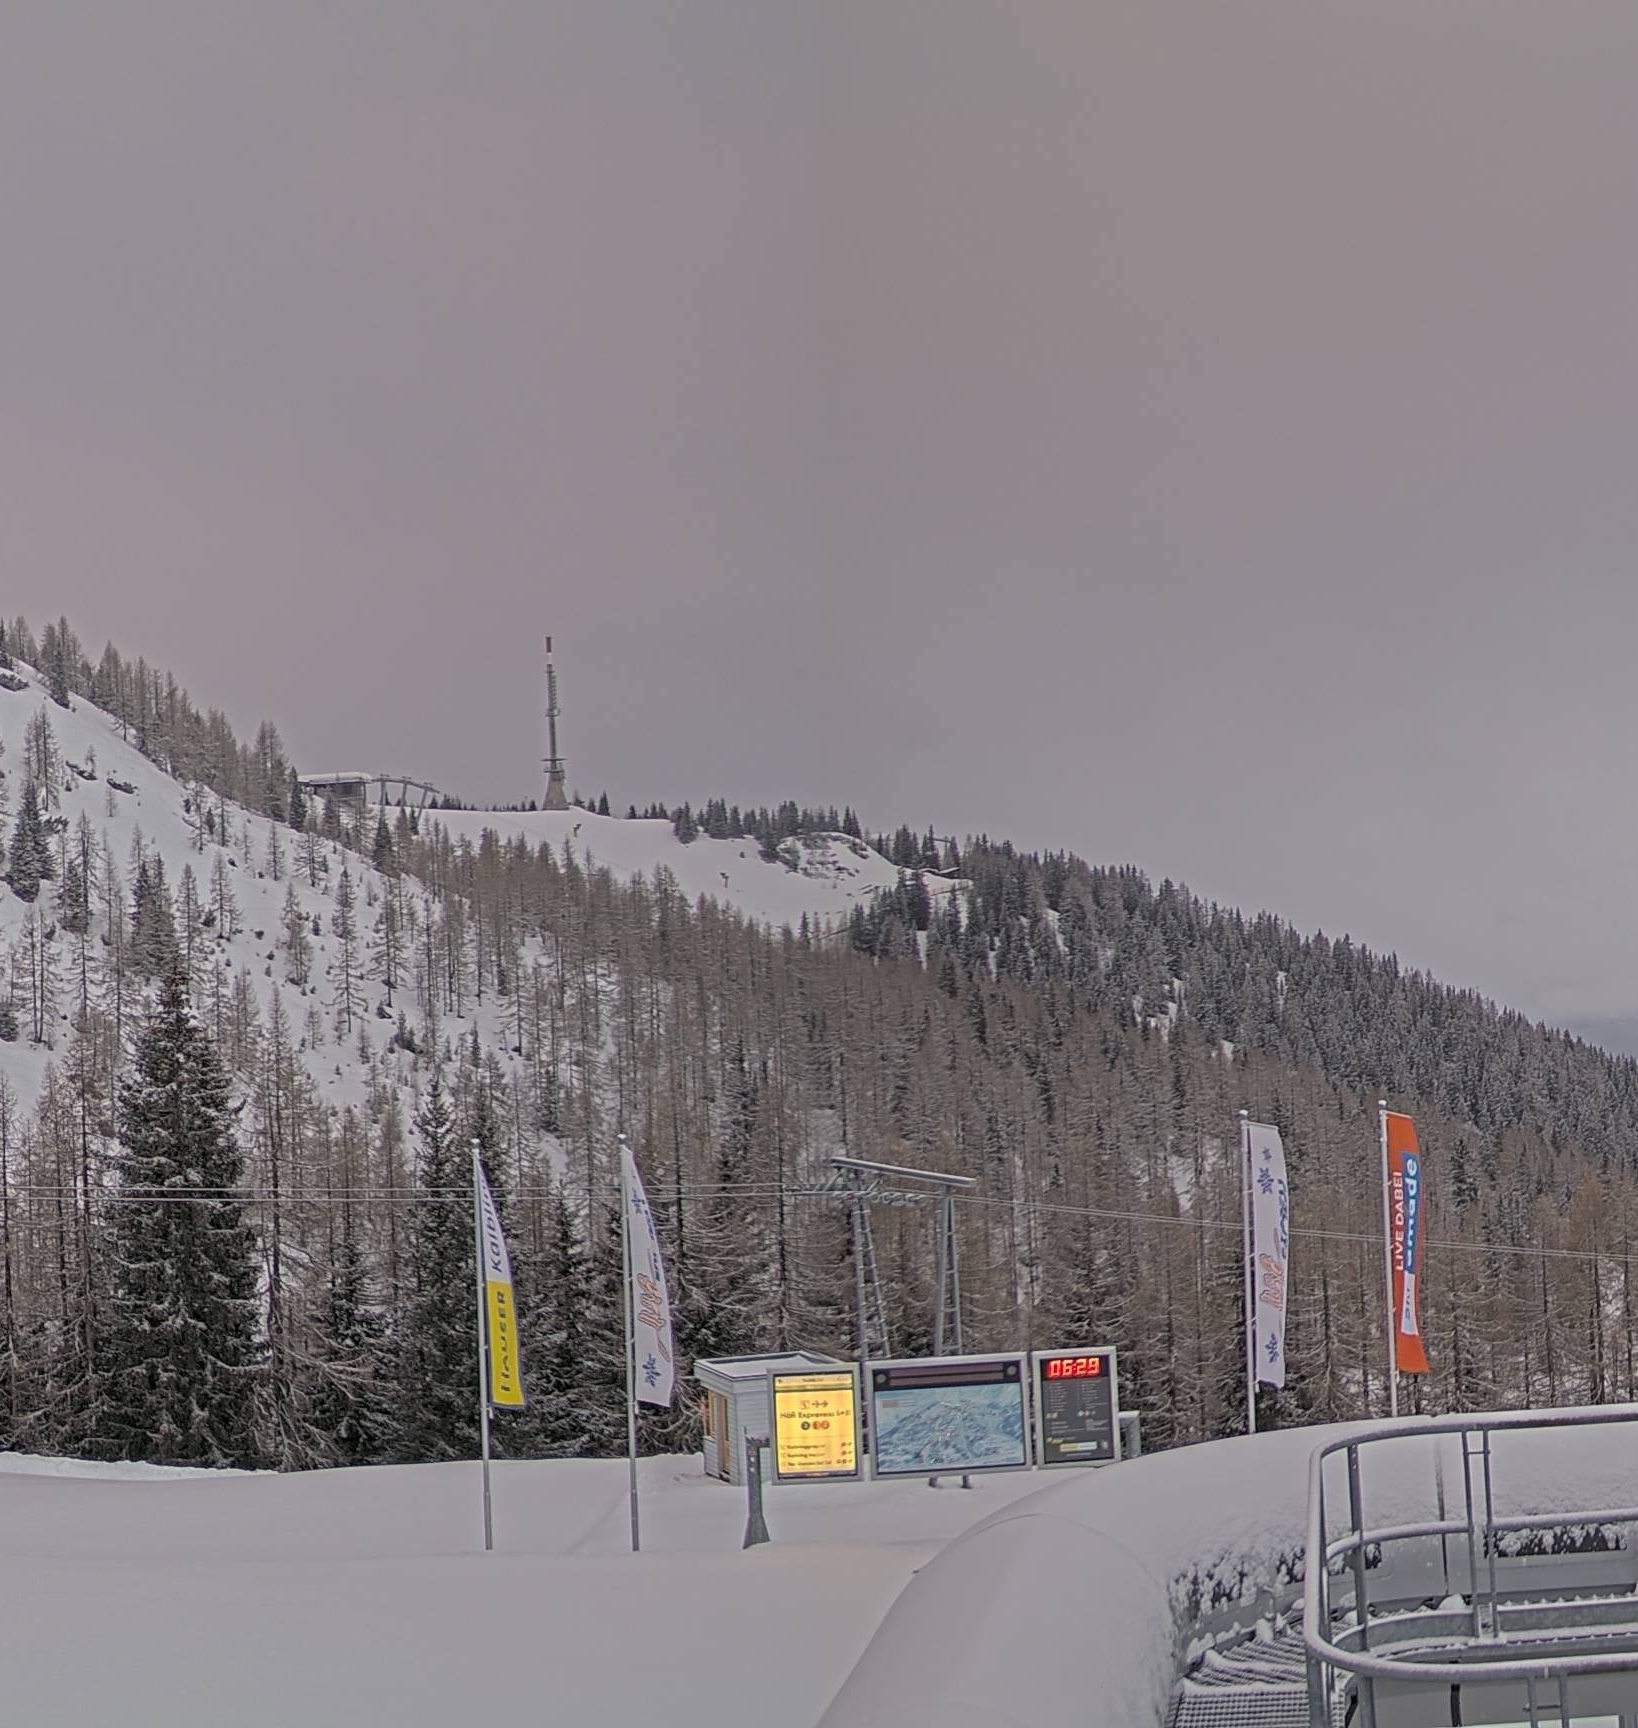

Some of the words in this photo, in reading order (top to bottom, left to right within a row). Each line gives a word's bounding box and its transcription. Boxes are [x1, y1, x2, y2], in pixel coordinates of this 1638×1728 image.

[1393, 1171, 1404, 1228] DABEI
[1395, 1230, 1405, 1271] LIVE
[1048, 1357, 1100, 1378] 06:29
